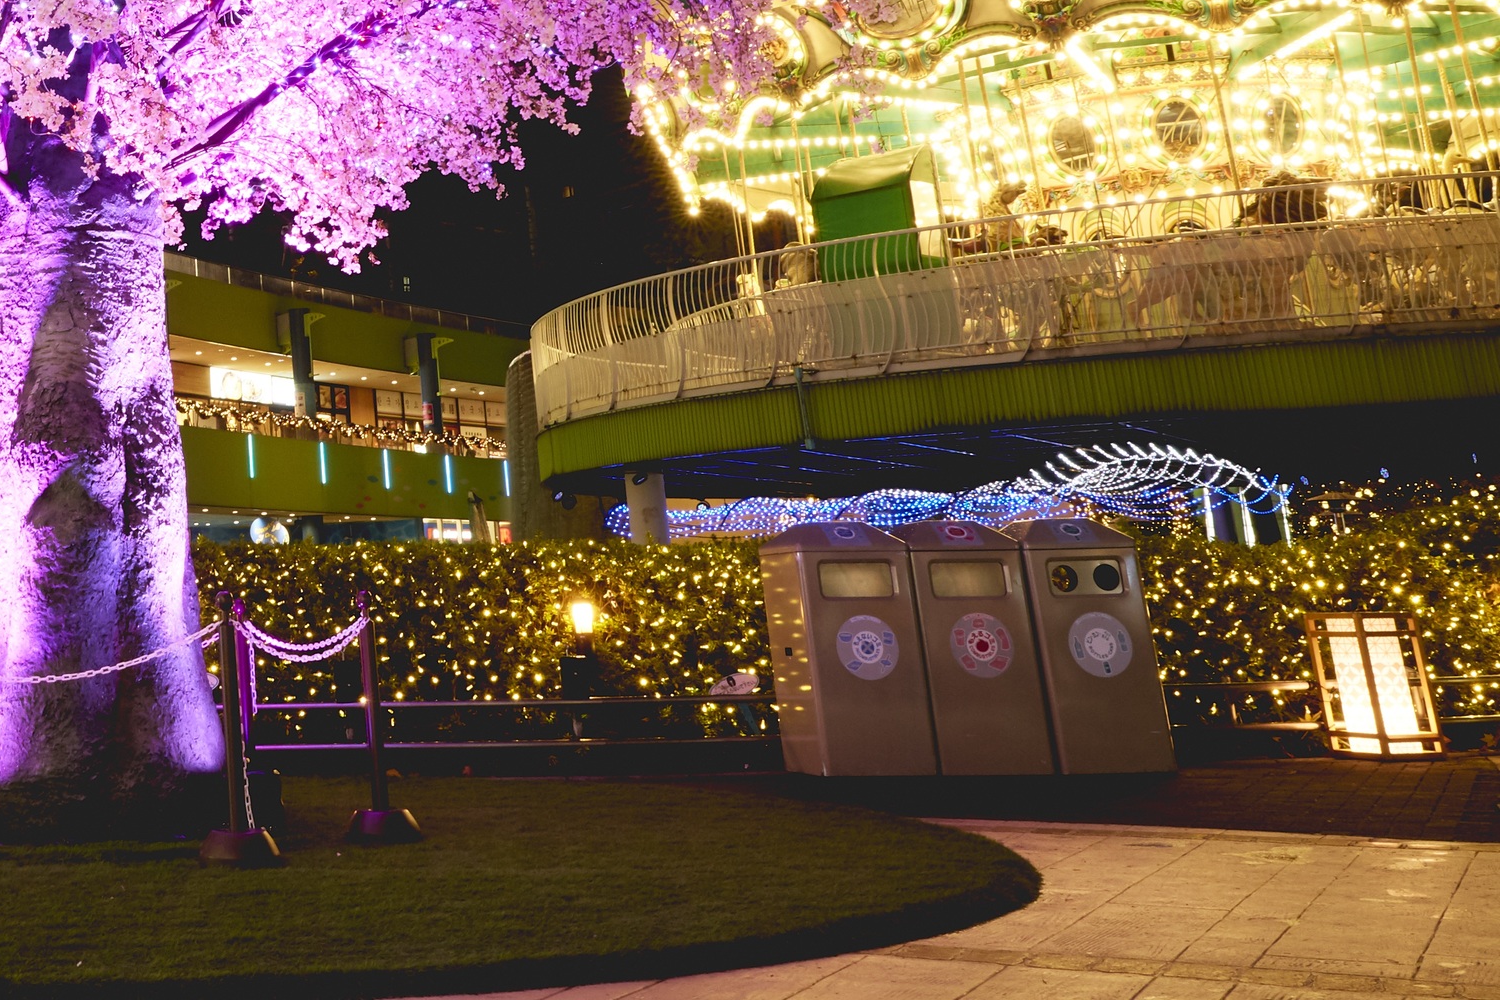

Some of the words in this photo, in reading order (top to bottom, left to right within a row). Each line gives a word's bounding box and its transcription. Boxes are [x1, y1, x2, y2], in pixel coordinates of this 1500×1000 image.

[853, 633, 882, 647] もえないゴミ
